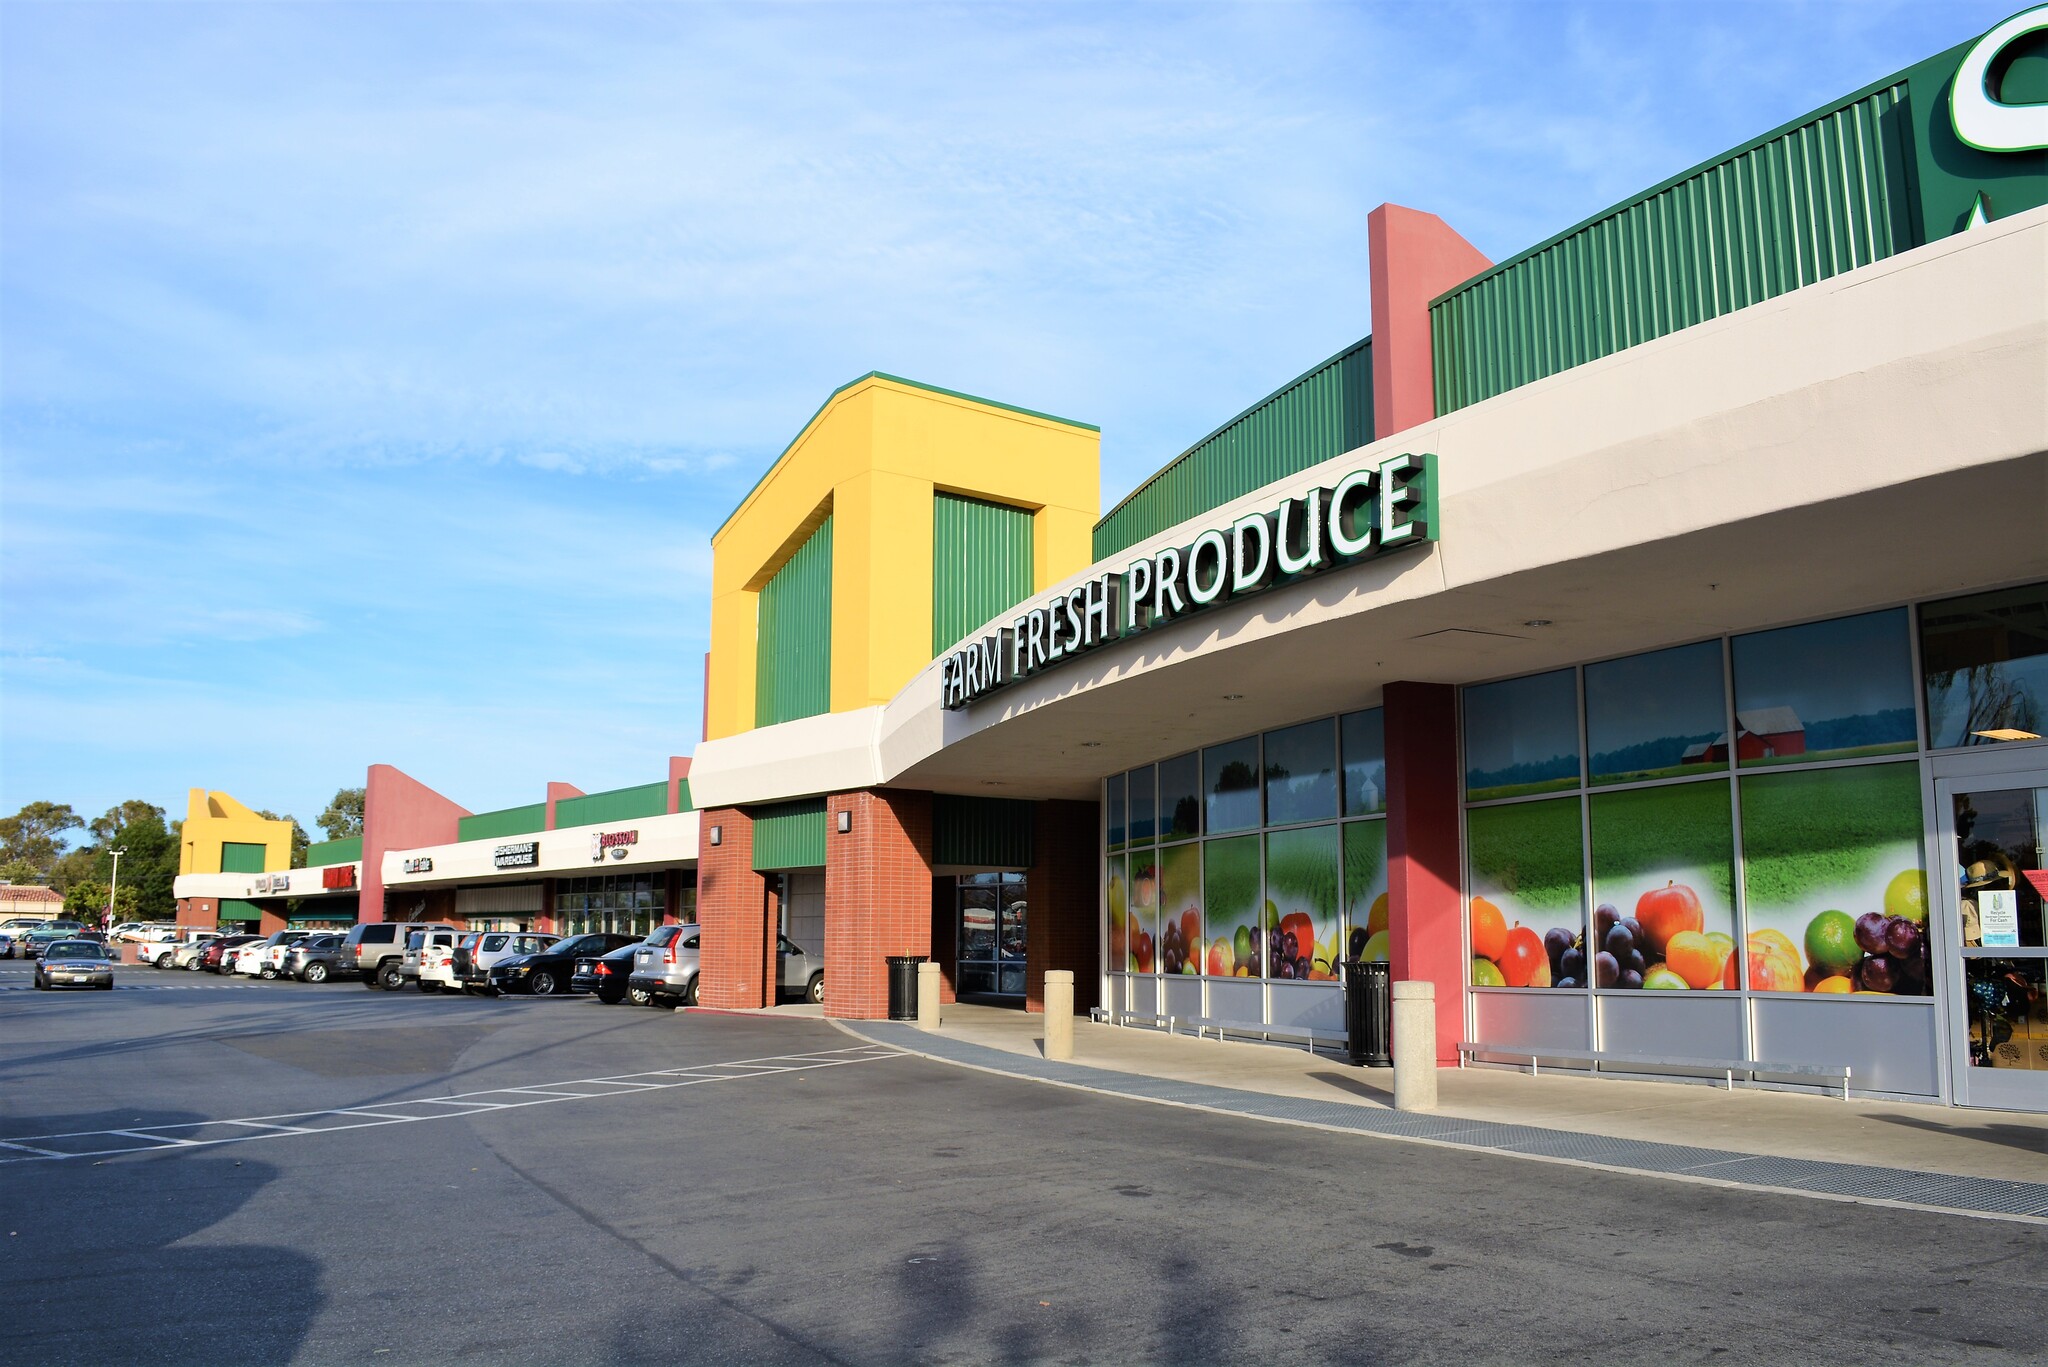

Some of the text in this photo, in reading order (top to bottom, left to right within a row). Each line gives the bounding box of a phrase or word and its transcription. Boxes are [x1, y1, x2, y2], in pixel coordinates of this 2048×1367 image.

[940, 453, 1416, 710] FARM FRESH PRODUCE
[601, 831, 635, 847] BLOSSOM
[495, 853, 533, 867] WAREHOUSE
